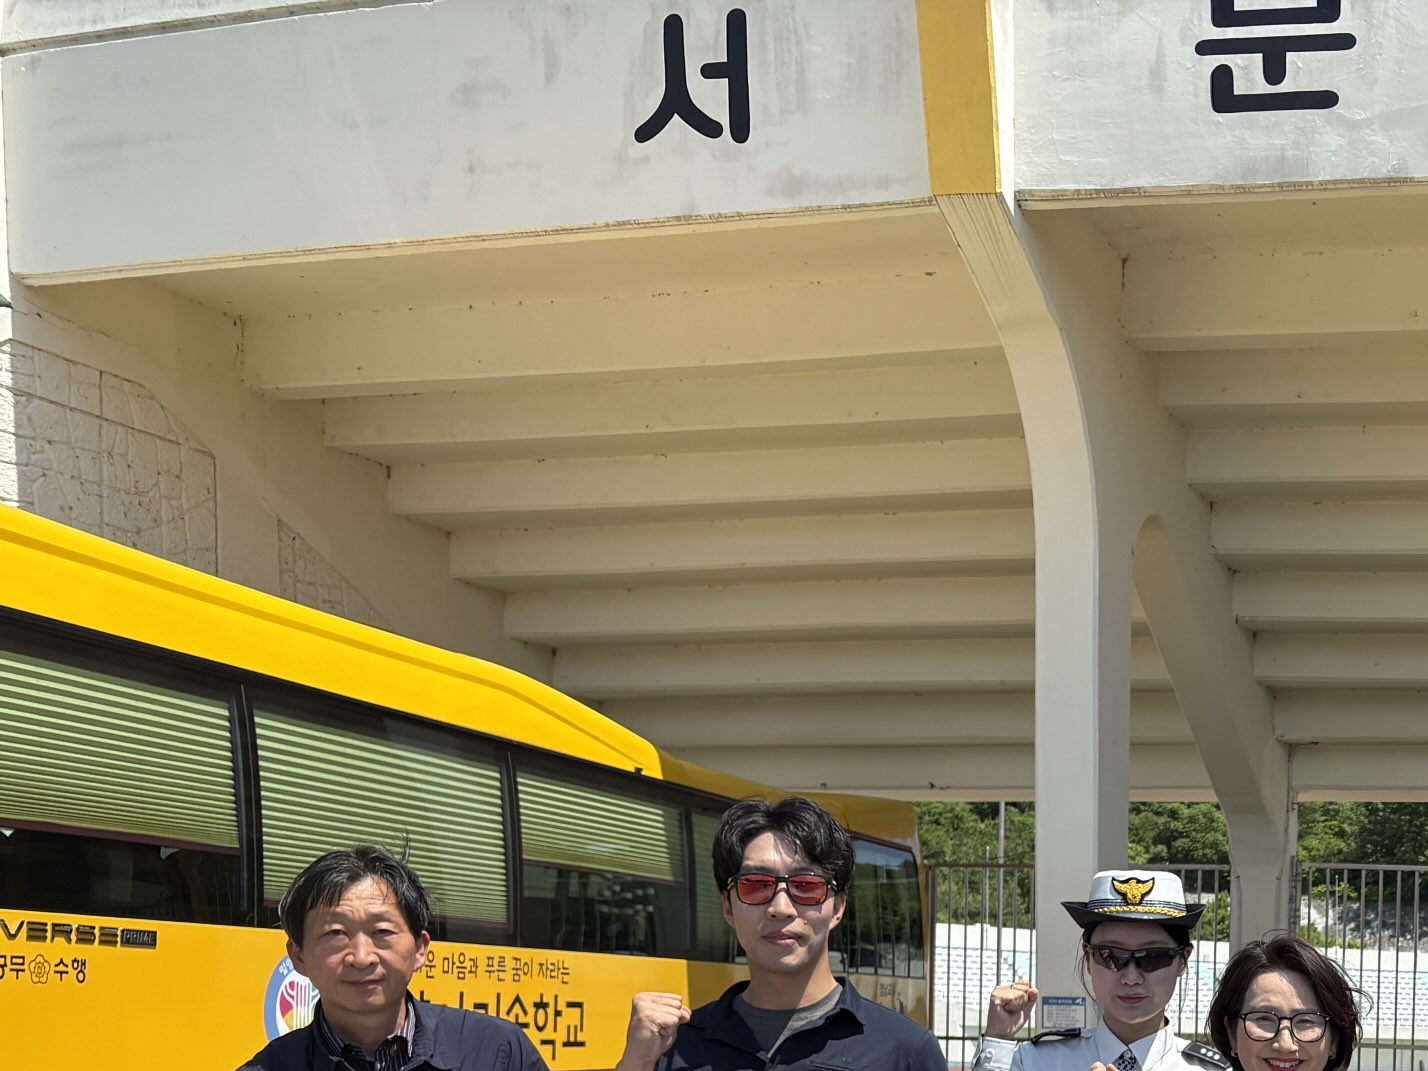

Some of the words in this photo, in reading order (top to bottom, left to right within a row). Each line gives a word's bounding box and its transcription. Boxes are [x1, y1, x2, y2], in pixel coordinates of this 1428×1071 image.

[634, 8, 750, 144] 서
[1194, 0, 1357, 113] 문
[54, 957, 87, 984] 수행
[442, 952, 479, 981] 마음과
[484, 956, 507, 982] 푸른
[512, 957, 534, 983] 꿈이
[537, 959, 570, 985] 자라는
